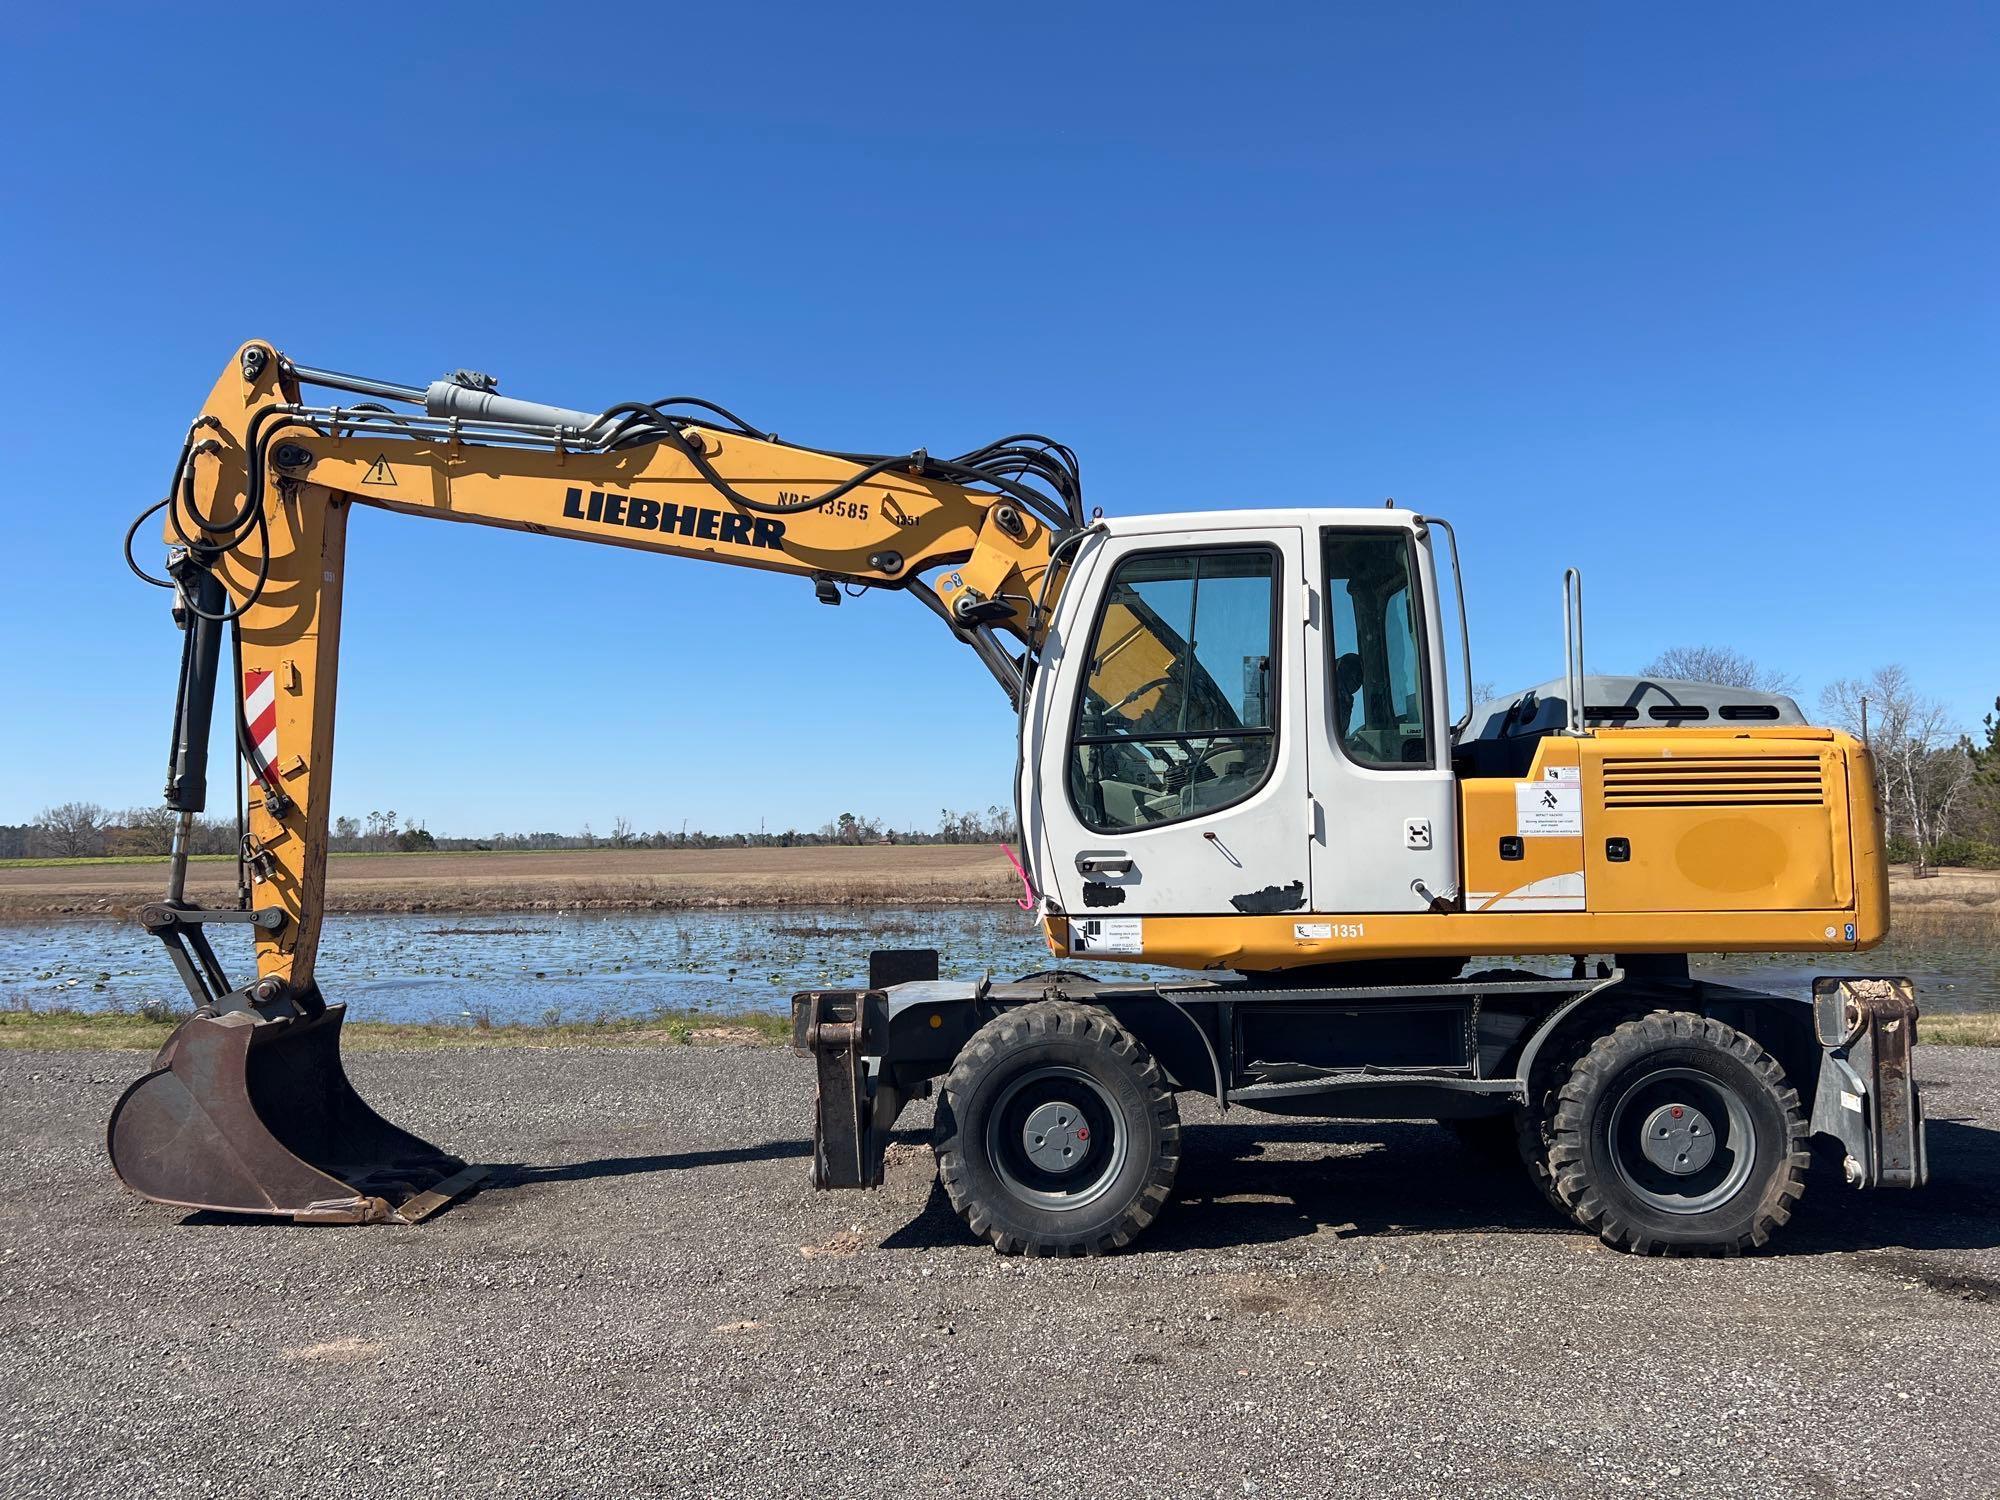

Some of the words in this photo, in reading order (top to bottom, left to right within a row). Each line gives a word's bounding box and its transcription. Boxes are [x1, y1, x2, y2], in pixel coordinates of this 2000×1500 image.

[563, 487, 787, 551] LIEBHERR
[896, 515, 920, 526] 1351
[1332, 923, 1364, 938] 1351
